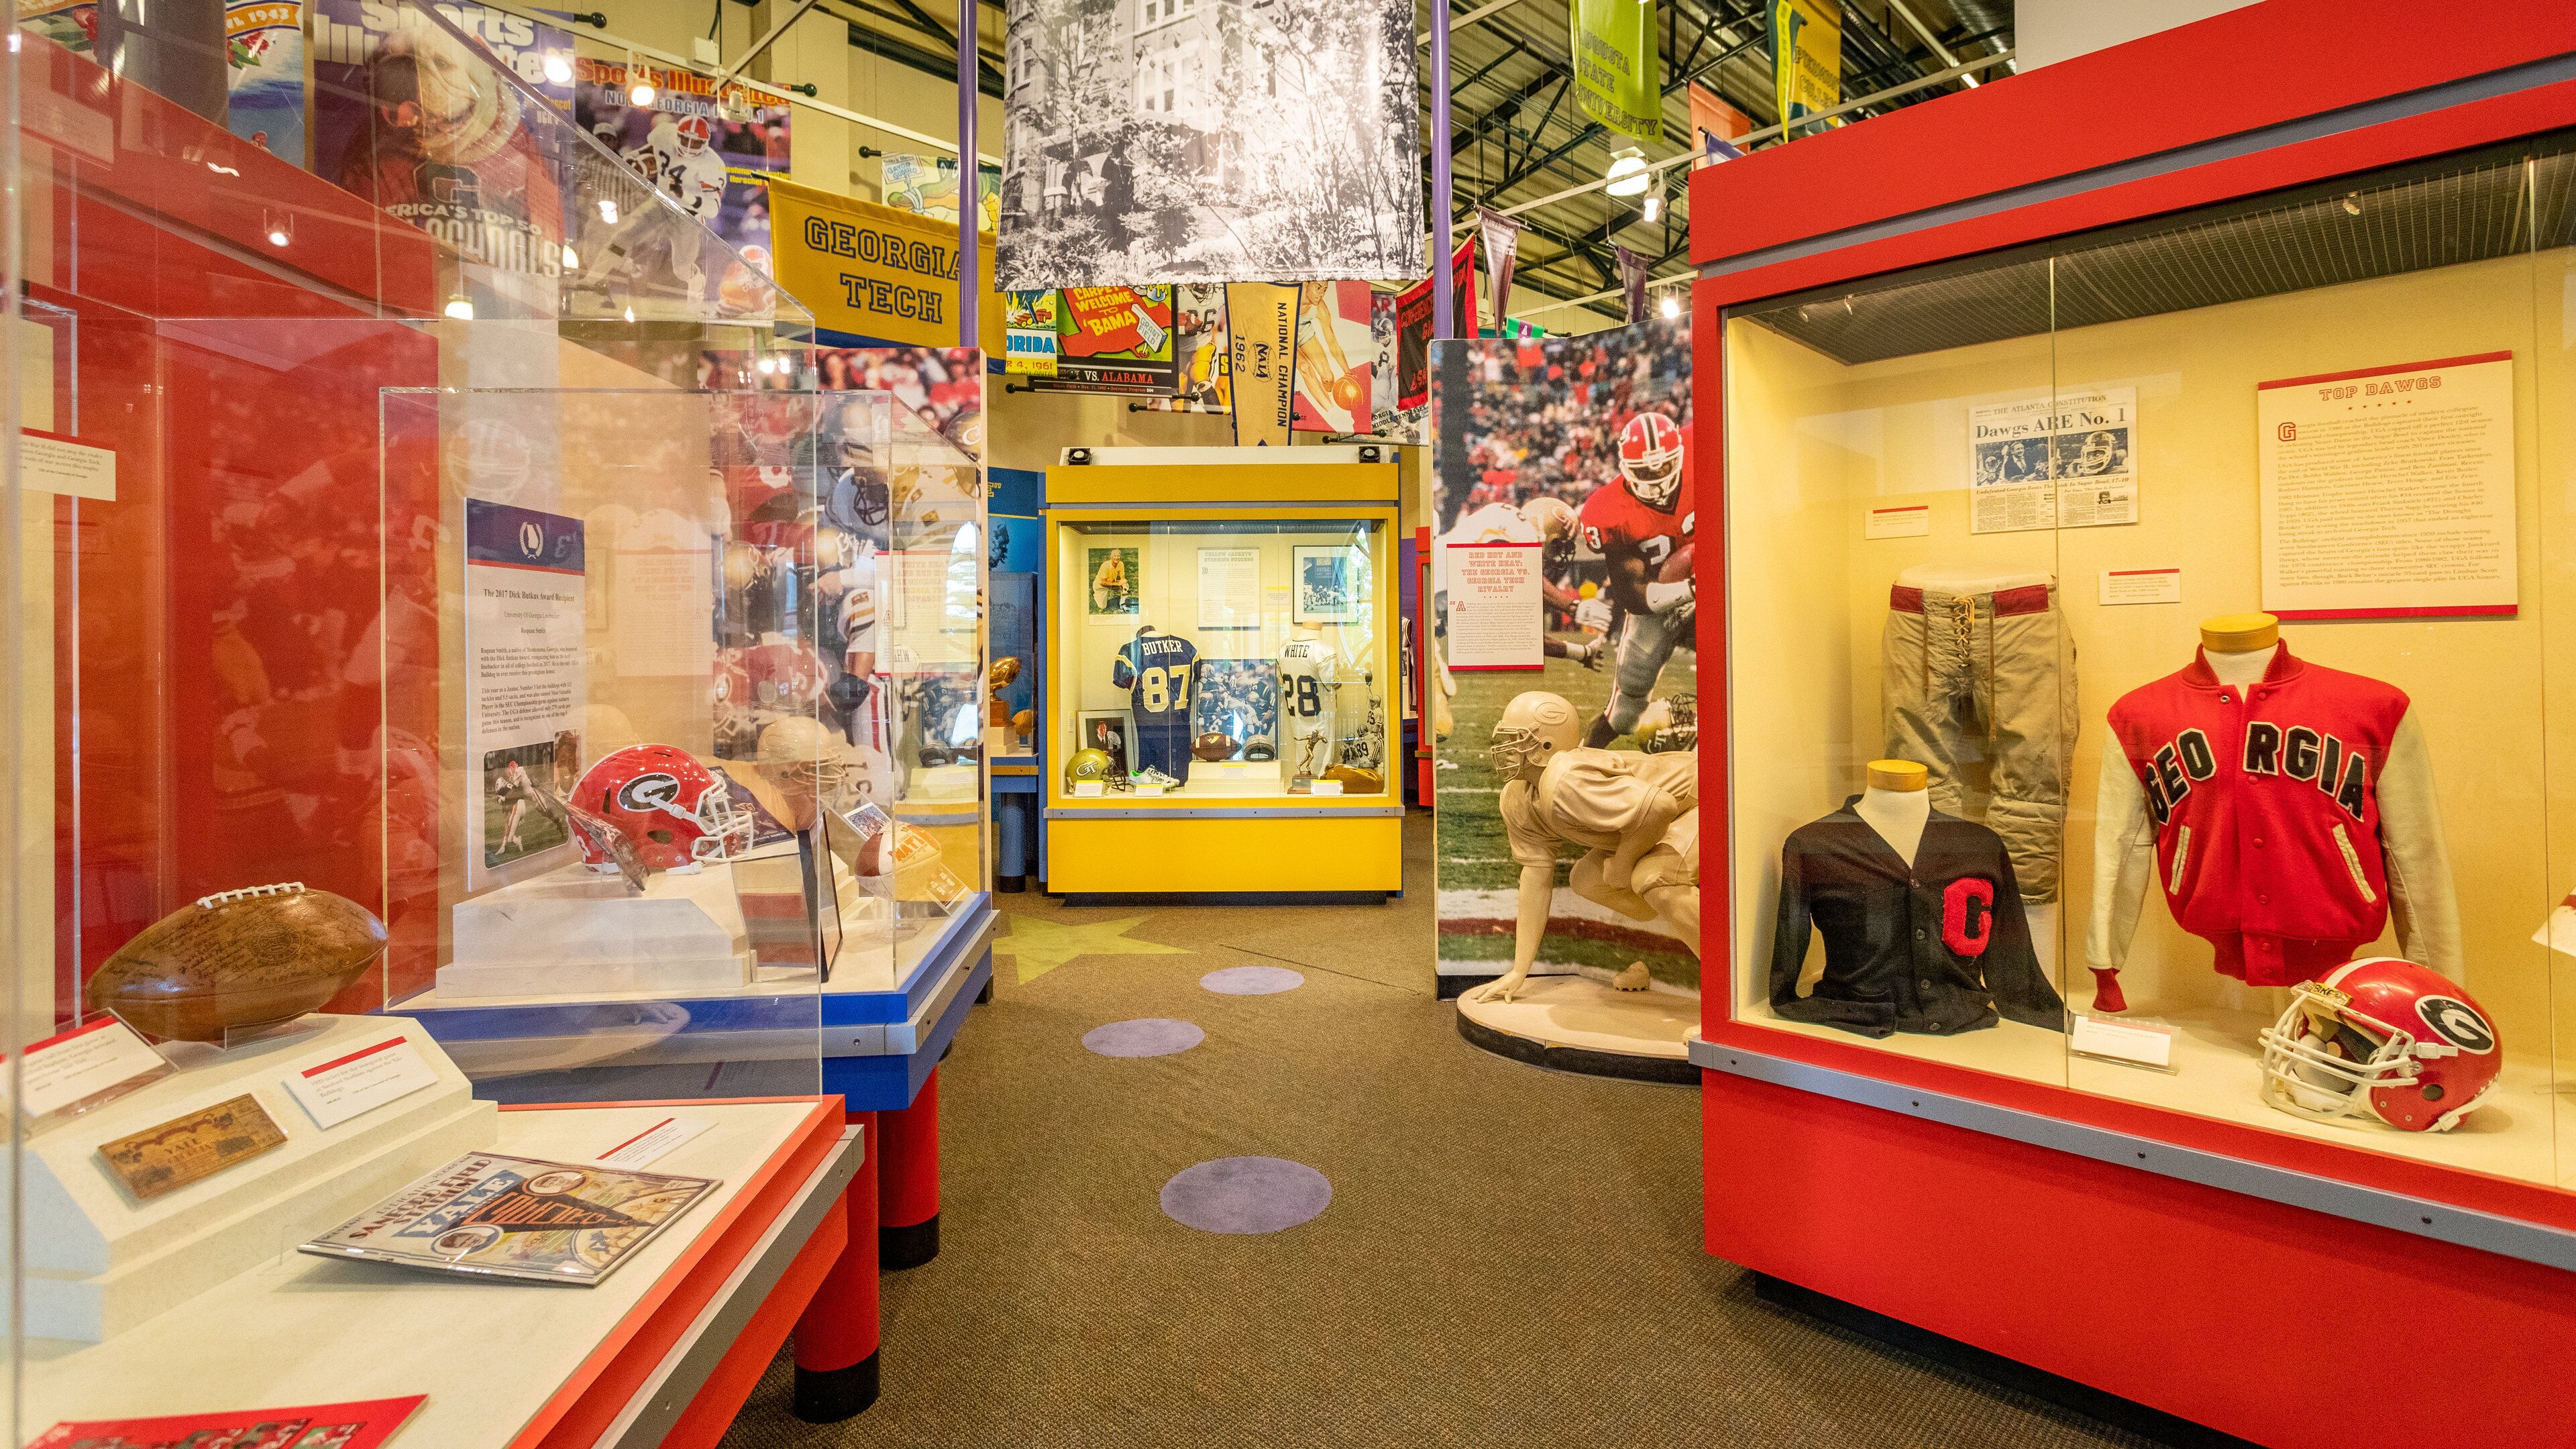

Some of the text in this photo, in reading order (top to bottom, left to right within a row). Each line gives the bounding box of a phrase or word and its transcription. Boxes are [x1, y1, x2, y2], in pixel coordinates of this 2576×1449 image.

[249, 7, 289, 23] 1943
[576, 57, 663, 89] Spos
[888, 162, 910, 173] GATOR
[472, 208, 513, 225] TOP
[513, 220, 542, 235] 50
[804, 216, 960, 281] GEORGIA
[840, 274, 943, 324] TECH
[1075, 291, 1134, 313] WELCOME
[1138, 325, 1155, 345] FIELD
[1140, 317, 1161, 339] GRANT
[1235, 334, 1246, 372] 1962
[1256, 343, 1269, 378] NAIA
[1277, 302, 1288, 427] NATIONAL CHAMPION
[1032, 362, 1053, 370] 1961
[1084, 370, 1099, 382] VS.
[1102, 373, 1153, 384] ALABAMA
[2319, 376, 2442, 401] TOP DAWGS
[2011, 402, 2045, 413] ATLANTA
[2047, 394, 2106, 408] CONSTITUTION
[1372, 417, 1394, 428] MIDDLE
[1976, 408, 2126, 438] Dawgs ARE No. 1
[2278, 422, 2296, 441] G
[484, 589, 494, 597] The
[496, 590, 507, 598] 2017
[510, 590, 521, 598] Dick
[522, 592, 539, 600] Butkus
[555, 593, 574, 603] Recipient
[1141, 639, 1183, 656] BUTKER
[1284, 644, 1309, 659] WHITE
[1142, 663, 1191, 713] 87
[1281, 674, 1322, 718] 28
[2313, 983, 2334, 997] BIKE
[437, 1158, 492, 1189] FIELD
[392, 1177, 480, 1225] STADIUM
[406, 1176, 516, 1236] YALE
